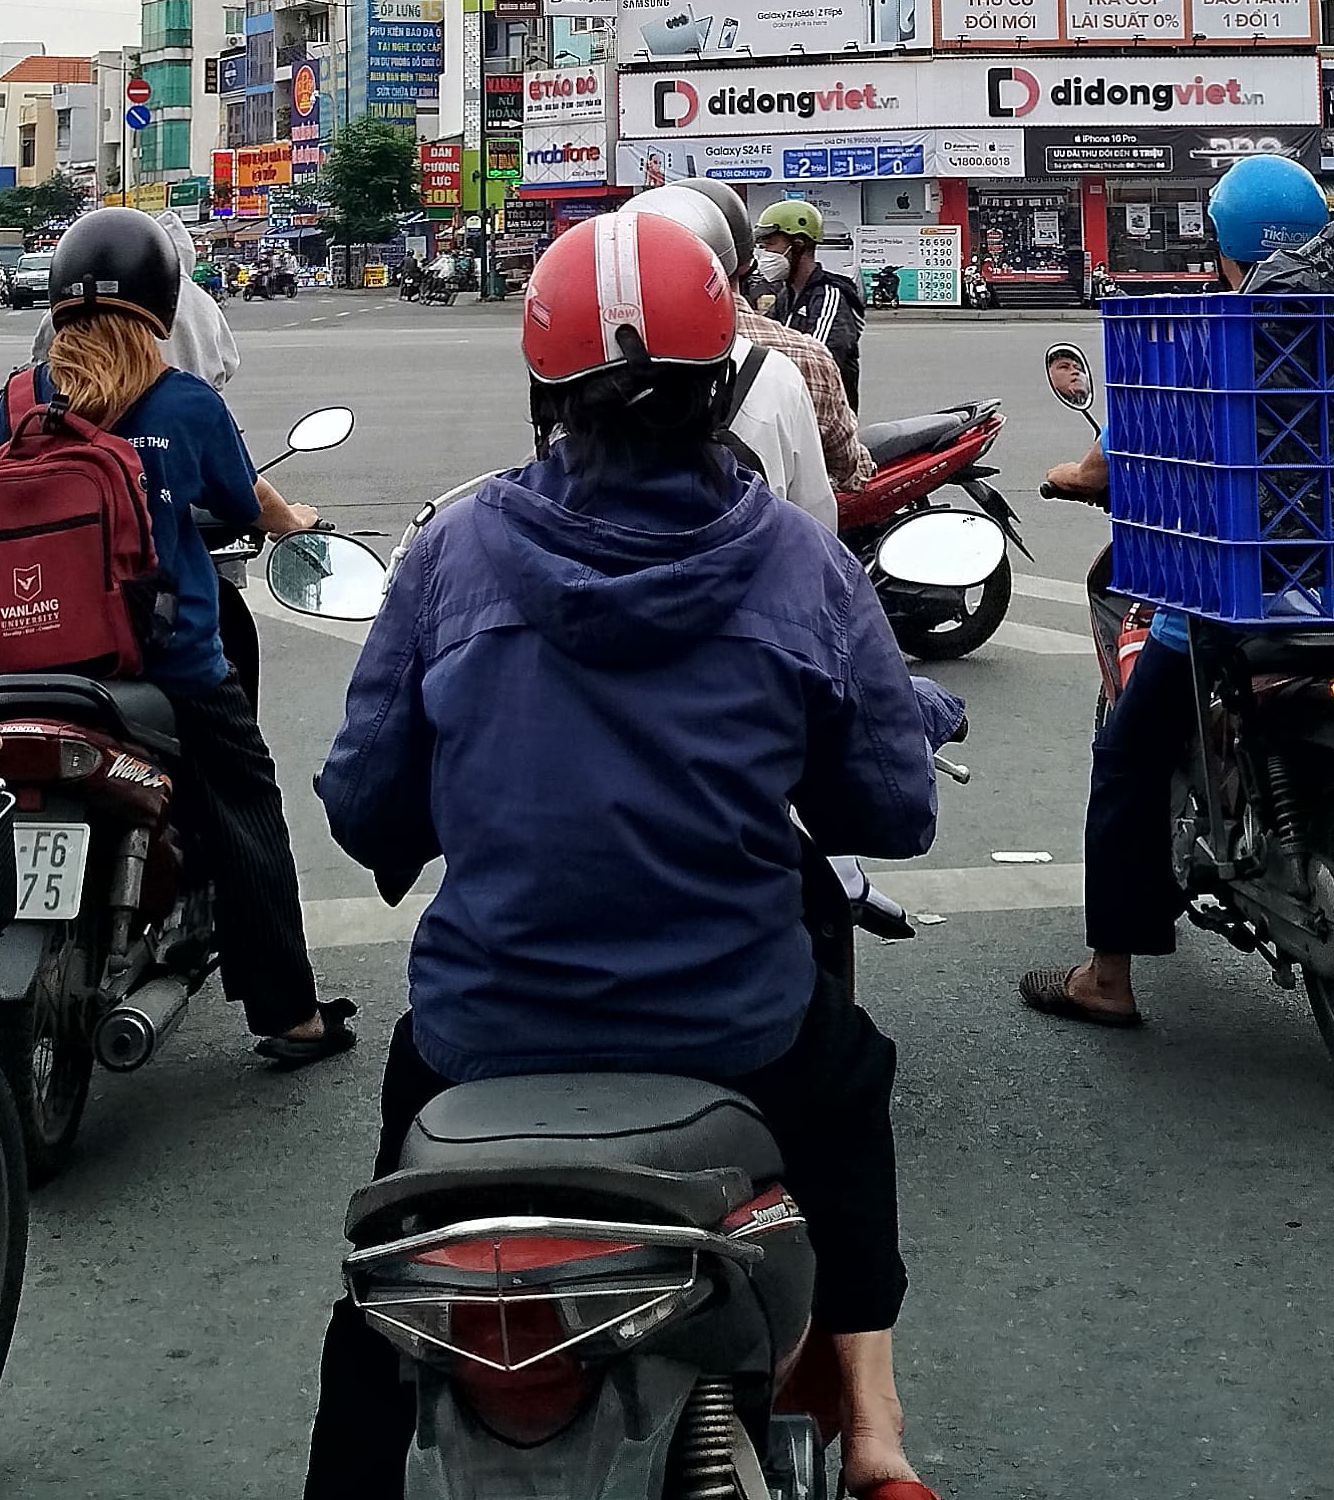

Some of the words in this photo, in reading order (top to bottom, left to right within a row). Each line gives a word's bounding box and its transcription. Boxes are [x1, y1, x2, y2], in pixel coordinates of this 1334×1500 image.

[964, 10, 1000, 29] ĐỔI
[1002, 13, 1037, 29] MỚI
[1071, 12, 1098, 29] LÃI
[1102, 9, 1150, 29] SUẤT
[1153, 13, 1180, 29] 0%
[1223, 14, 1230, 28] 1
[1235, 8, 1267, 28] ĐỔI
[1272, 13, 1280, 27] 1
[707, 82, 900, 118] didongviet.vn
[1051, 76, 1264, 112] didongviet.vn
[527, 142, 601, 166] mobifone
[705, 145, 741, 158] Galaxy
[743, 144, 760, 155] S24
[761, 144, 772, 154] FE
[798, 157, 811, 177] 2
[847, 156, 854, 175] 1
[607, 306, 636, 320] New
[0, 599, 59, 619] VANLANG
[0, 612, 60, 629] UNIVERSITY
[1, 725, 44, 734] HONDA
[19, 873, 62, 910] 75
